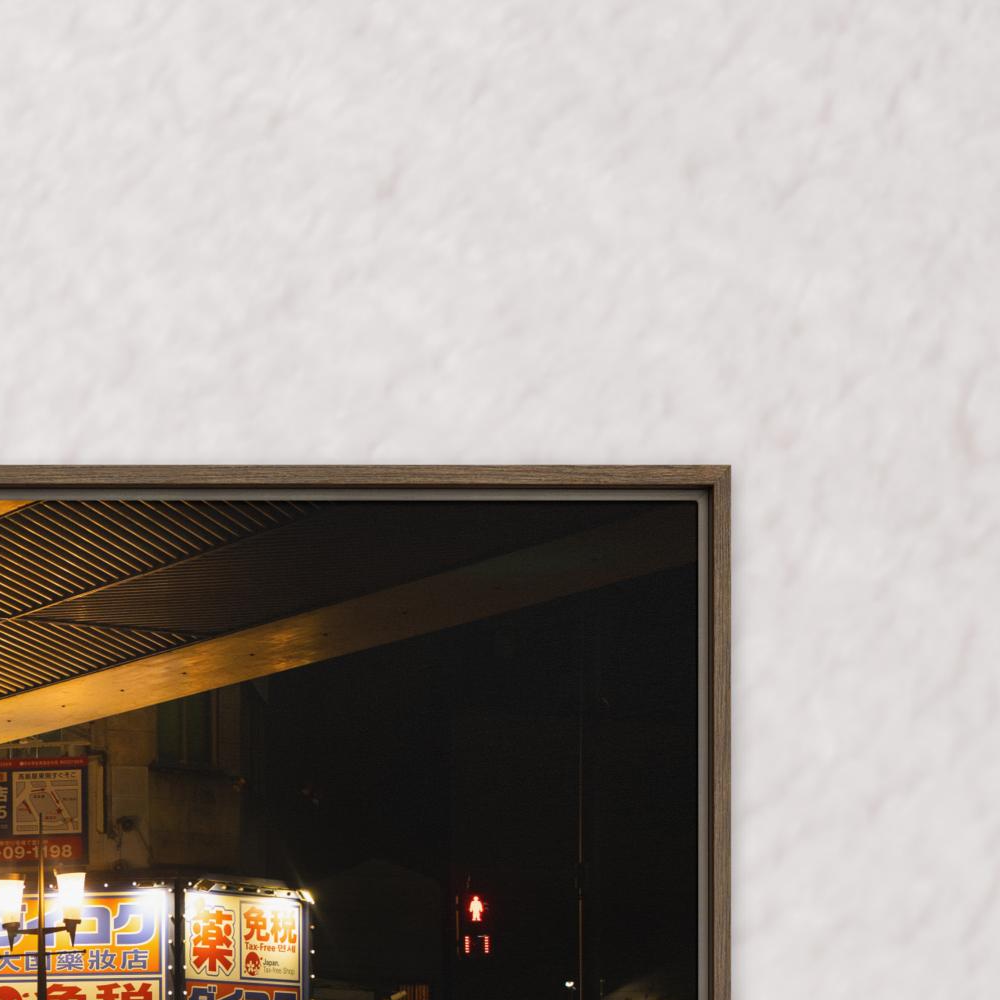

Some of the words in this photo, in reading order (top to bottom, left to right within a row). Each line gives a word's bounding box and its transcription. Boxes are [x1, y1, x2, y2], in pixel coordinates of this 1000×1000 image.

[191, 908, 234, 973] 薬
[243, 905, 297, 944] 免税
[244, 942, 276, 953] Tax-Free
